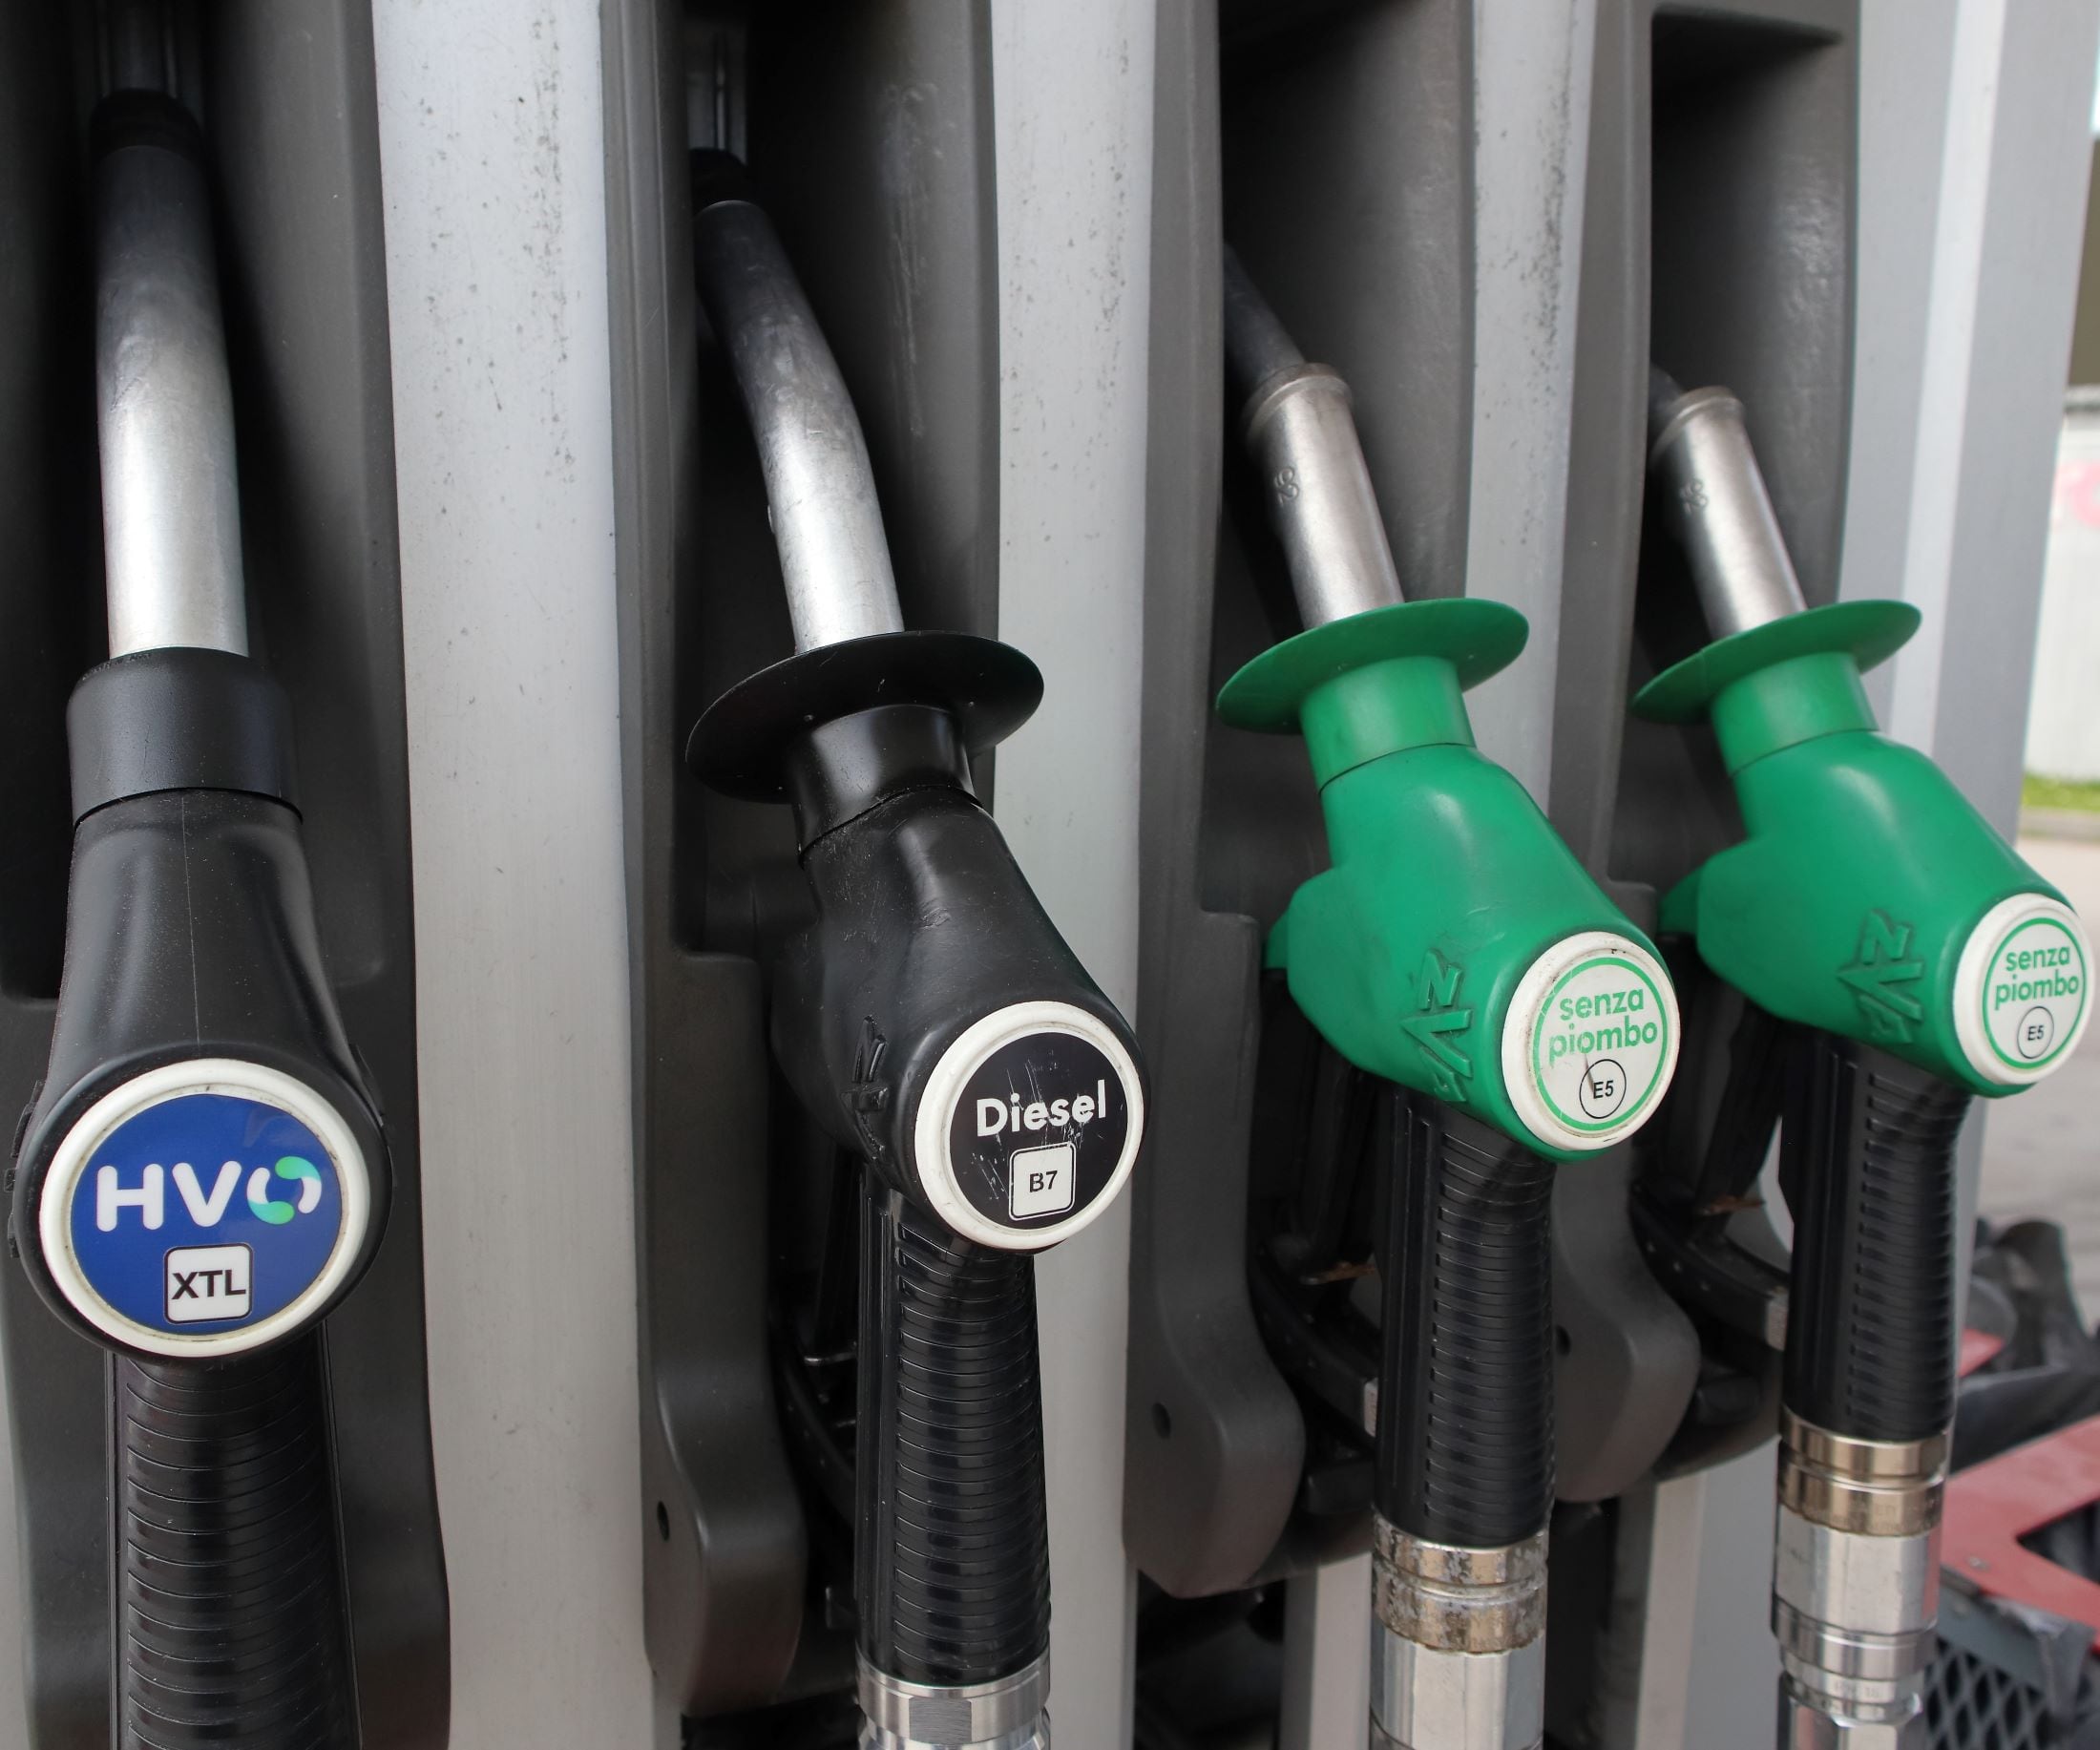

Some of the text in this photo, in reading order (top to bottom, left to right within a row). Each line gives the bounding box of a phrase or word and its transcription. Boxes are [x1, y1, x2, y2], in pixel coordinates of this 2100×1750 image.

[2006, 945, 2070, 972] senza
[1559, 987, 1645, 1022] senza
[1994, 968, 2080, 1011] piombo
[1547, 1015, 1658, 1068] piombo
[2026, 1024, 2045, 1042] E5
[1592, 1079, 1614, 1100] E5
[976, 1078, 1107, 1138] Diesel
[96, 1155, 323, 1233] HVO
[1028, 1170, 1059, 1193] B7
[172, 1269, 247, 1300] XTL
